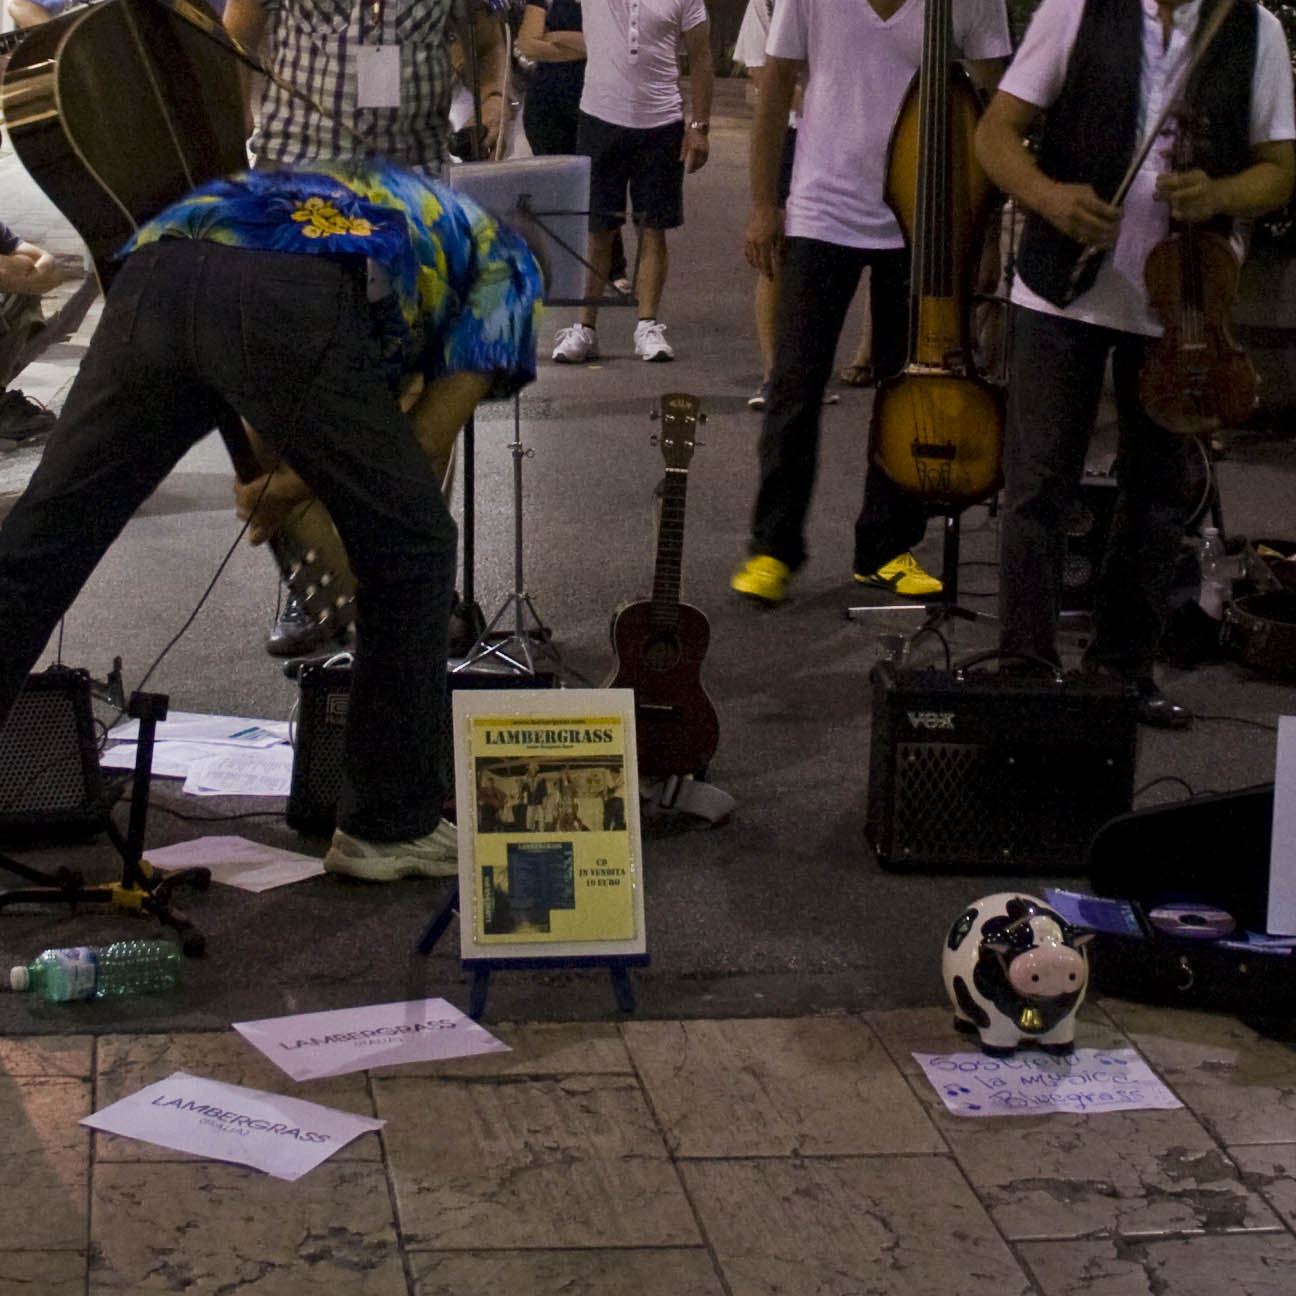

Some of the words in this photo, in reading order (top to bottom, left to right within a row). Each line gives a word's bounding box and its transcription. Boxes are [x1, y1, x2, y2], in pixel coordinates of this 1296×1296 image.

[907, 711, 956, 729] VOX
[485, 728, 613, 745] LAMBERGRASS
[278, 1019, 457, 1051] LAMBERGRASS
[974, 1075, 1007, 1090] la
[151, 1095, 331, 1144] LAMBERGRASS
